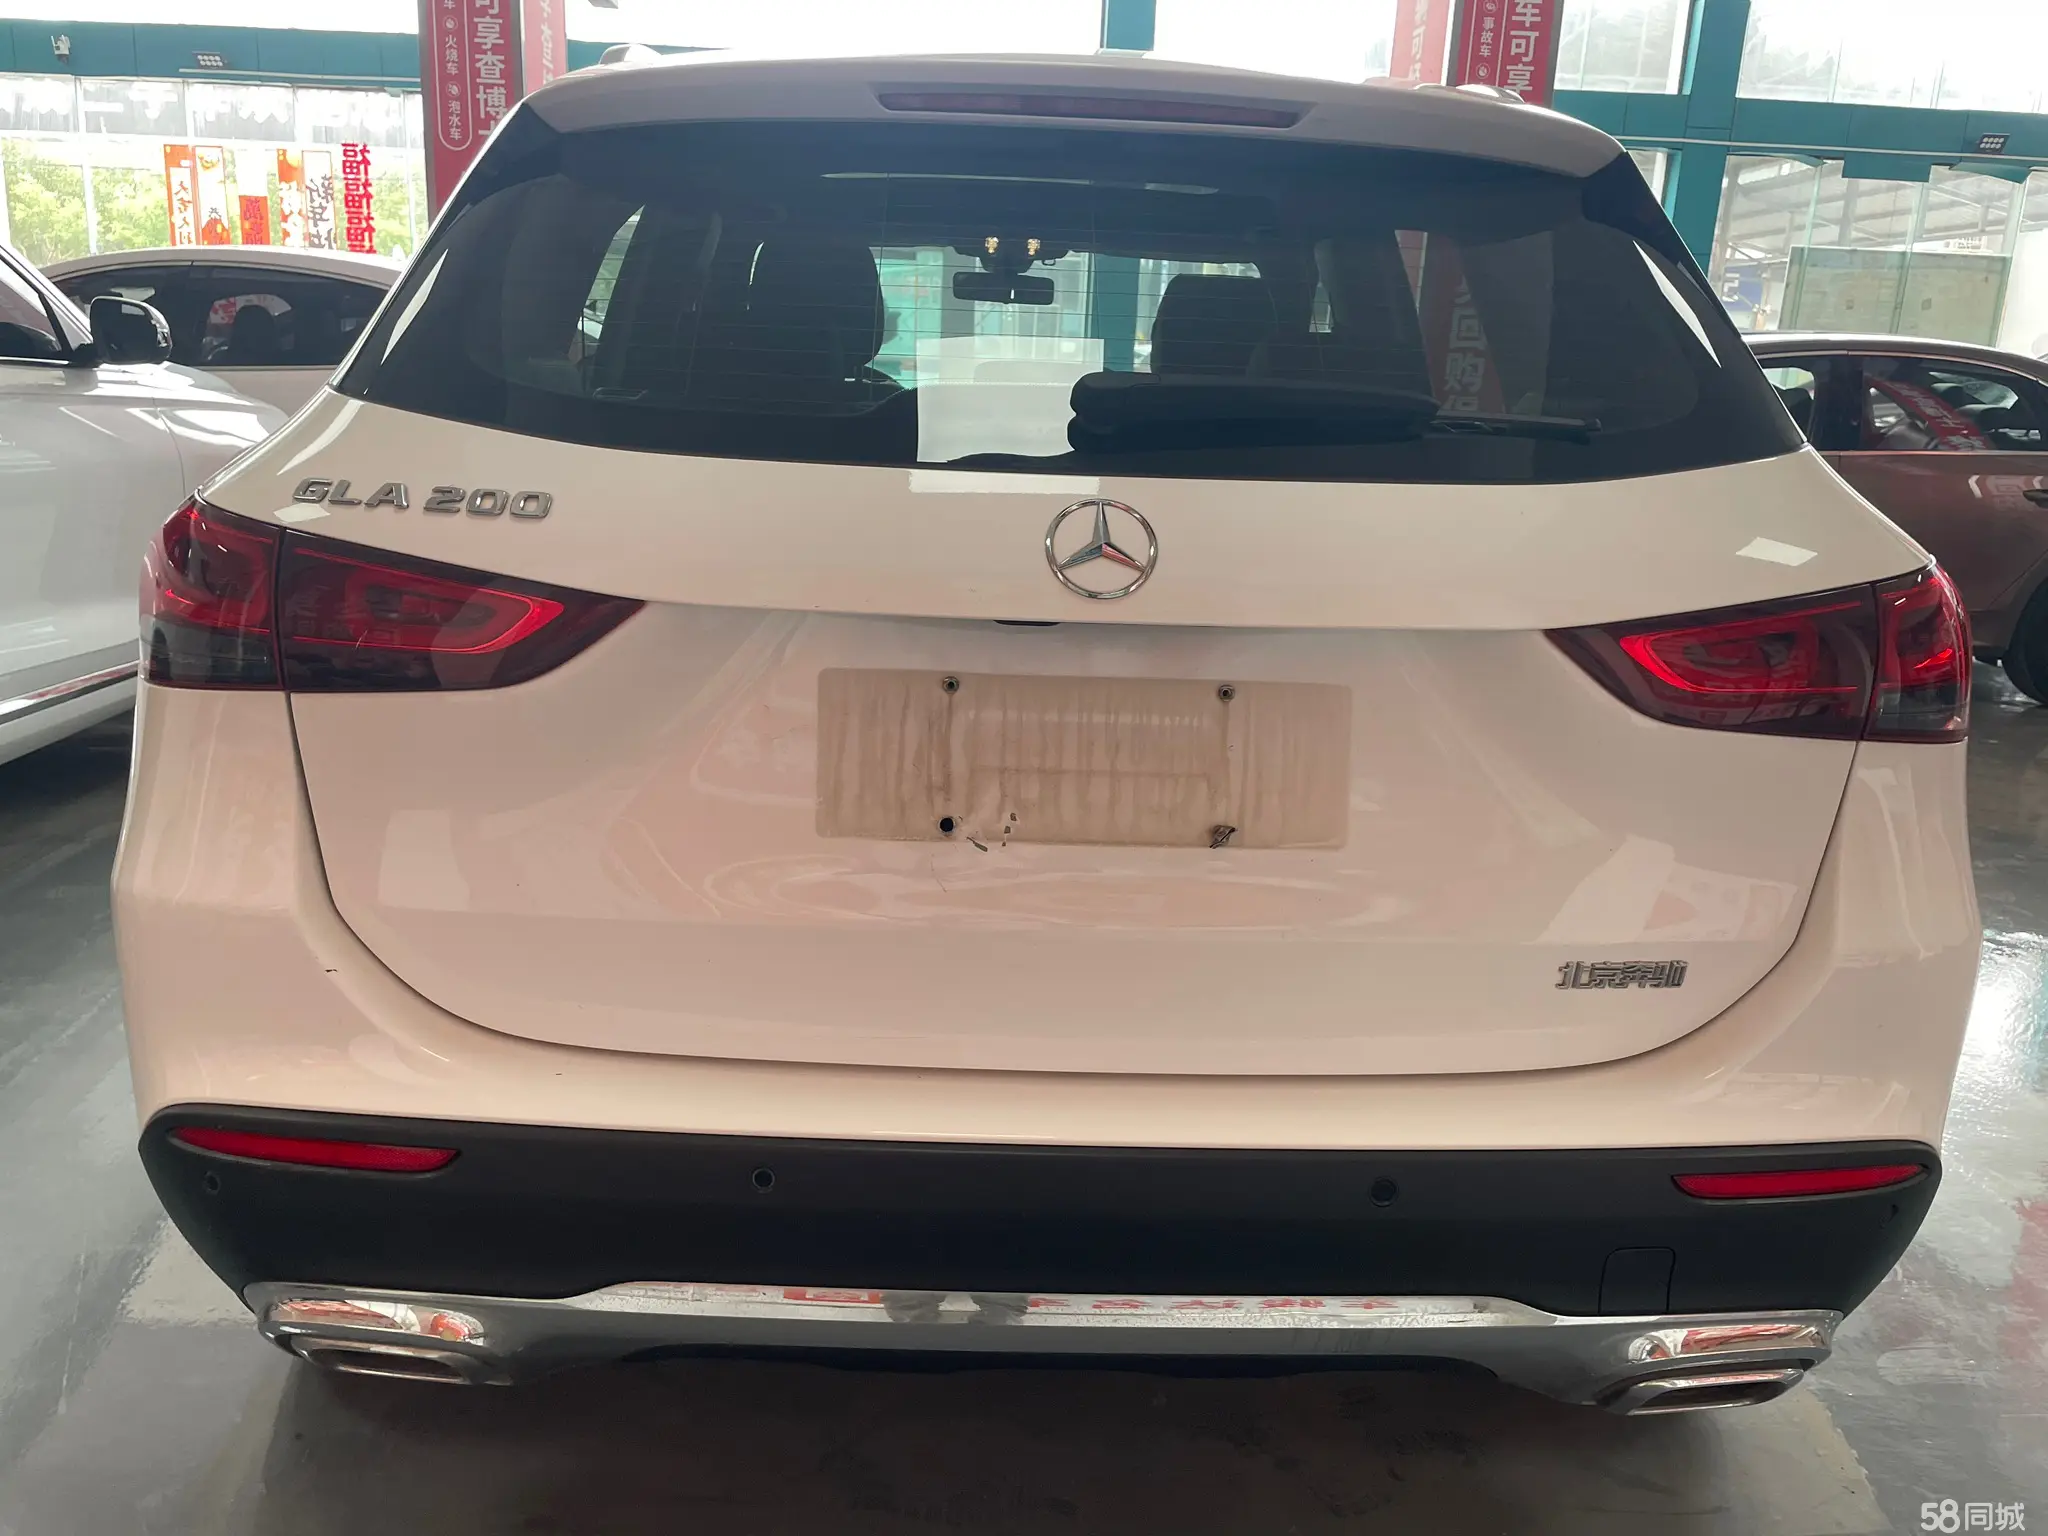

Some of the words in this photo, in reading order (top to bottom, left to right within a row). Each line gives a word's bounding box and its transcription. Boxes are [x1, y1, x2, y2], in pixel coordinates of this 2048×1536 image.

[445, 34, 459, 75] 火烧车
[1479, 17, 1495, 57] 事故车
[1504, 0, 1542, 94] 车可享
[448, 100, 462, 140] 泡水车
[292, 477, 409, 509] GLA
[423, 485, 553, 519] 200
[1555, 960, 1689, 989] 北京奔驰
